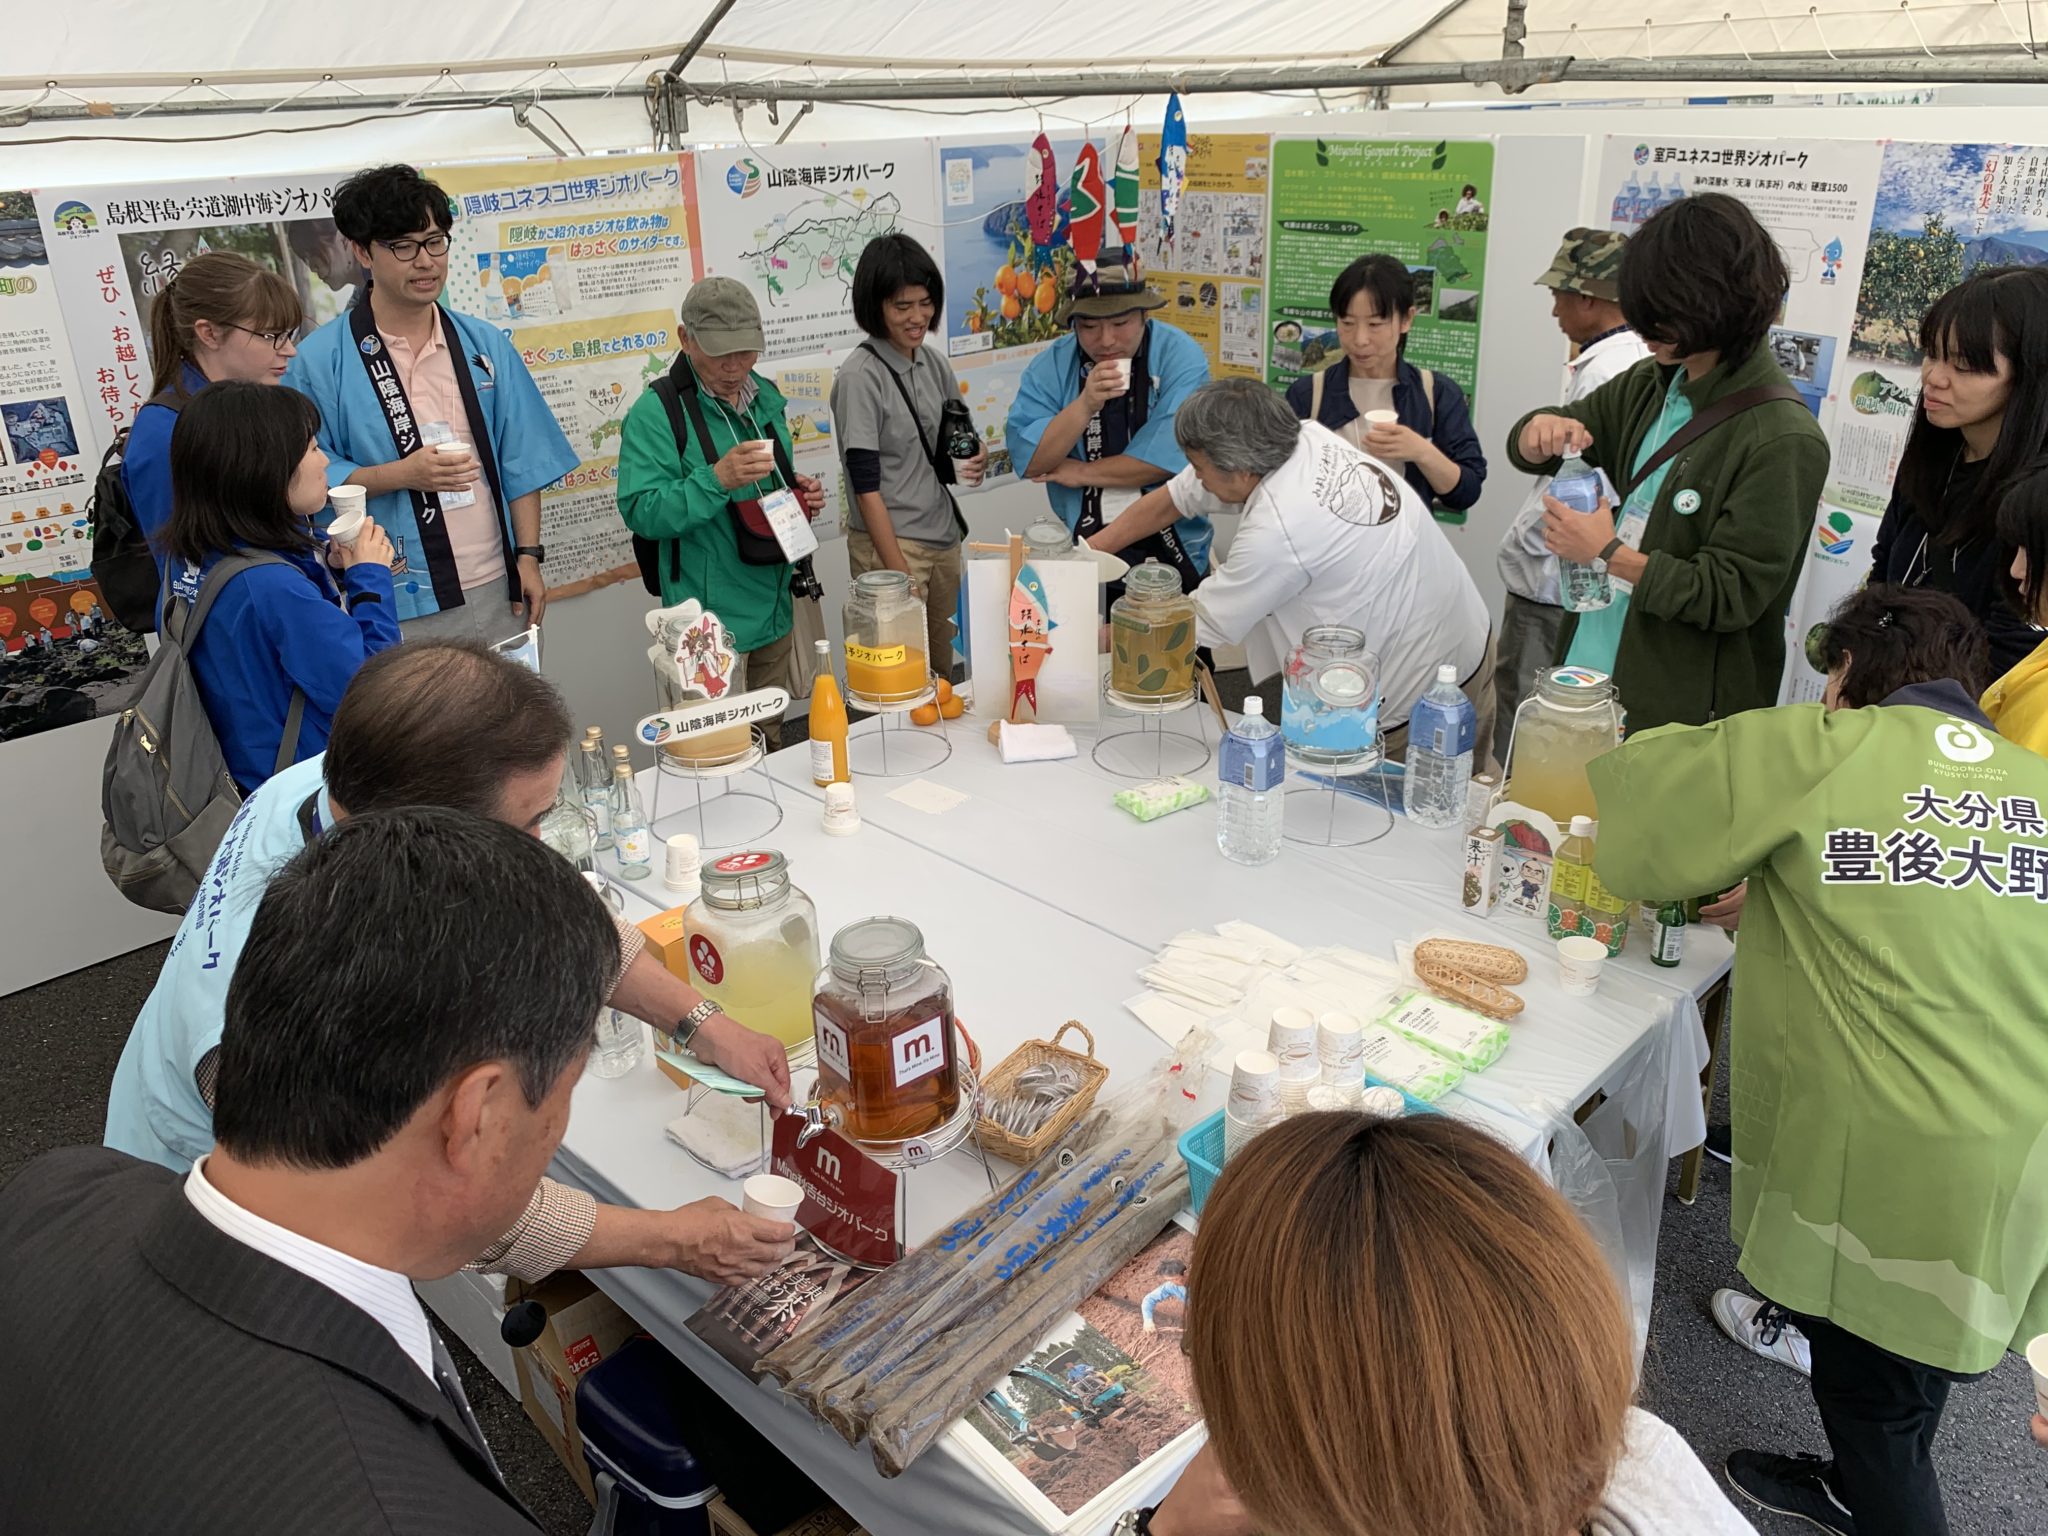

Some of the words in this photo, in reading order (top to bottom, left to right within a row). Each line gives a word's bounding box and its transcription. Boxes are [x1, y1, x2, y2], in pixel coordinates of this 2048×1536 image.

[1653, 147, 1809, 169] 室戸ユネスコ世界ジオパーク
[766, 162, 895, 188] 山陰海岸ジオパーク
[1994, 155, 2014, 214] 知る人ぞ知る
[2021, 156, 2039, 215] 自然の恵みを
[464, 168, 680, 217] 隠岐ユネスコ世界ジオパーク
[509, 214, 669, 244] 隠岐がご紹介するジオな飲み物は
[570, 235, 686, 257] はっさくのサイダーです。
[675, 697, 783, 735] 山陰海岸ジオパーク
[1934, 768, 1969, 779] KYUSYU
[1972, 772, 2003, 782] JAPAN
[1986, 767, 2008, 776] OITA
[1904, 785, 2046, 836] 大分県
[1467, 839, 1482, 867] 果汁
[1823, 829, 2048, 902] 豊後大野
[785, 1272, 828, 1303] 美東
[750, 1308, 775, 1330] Goboh
[775, 1325, 789, 1342] Tea
